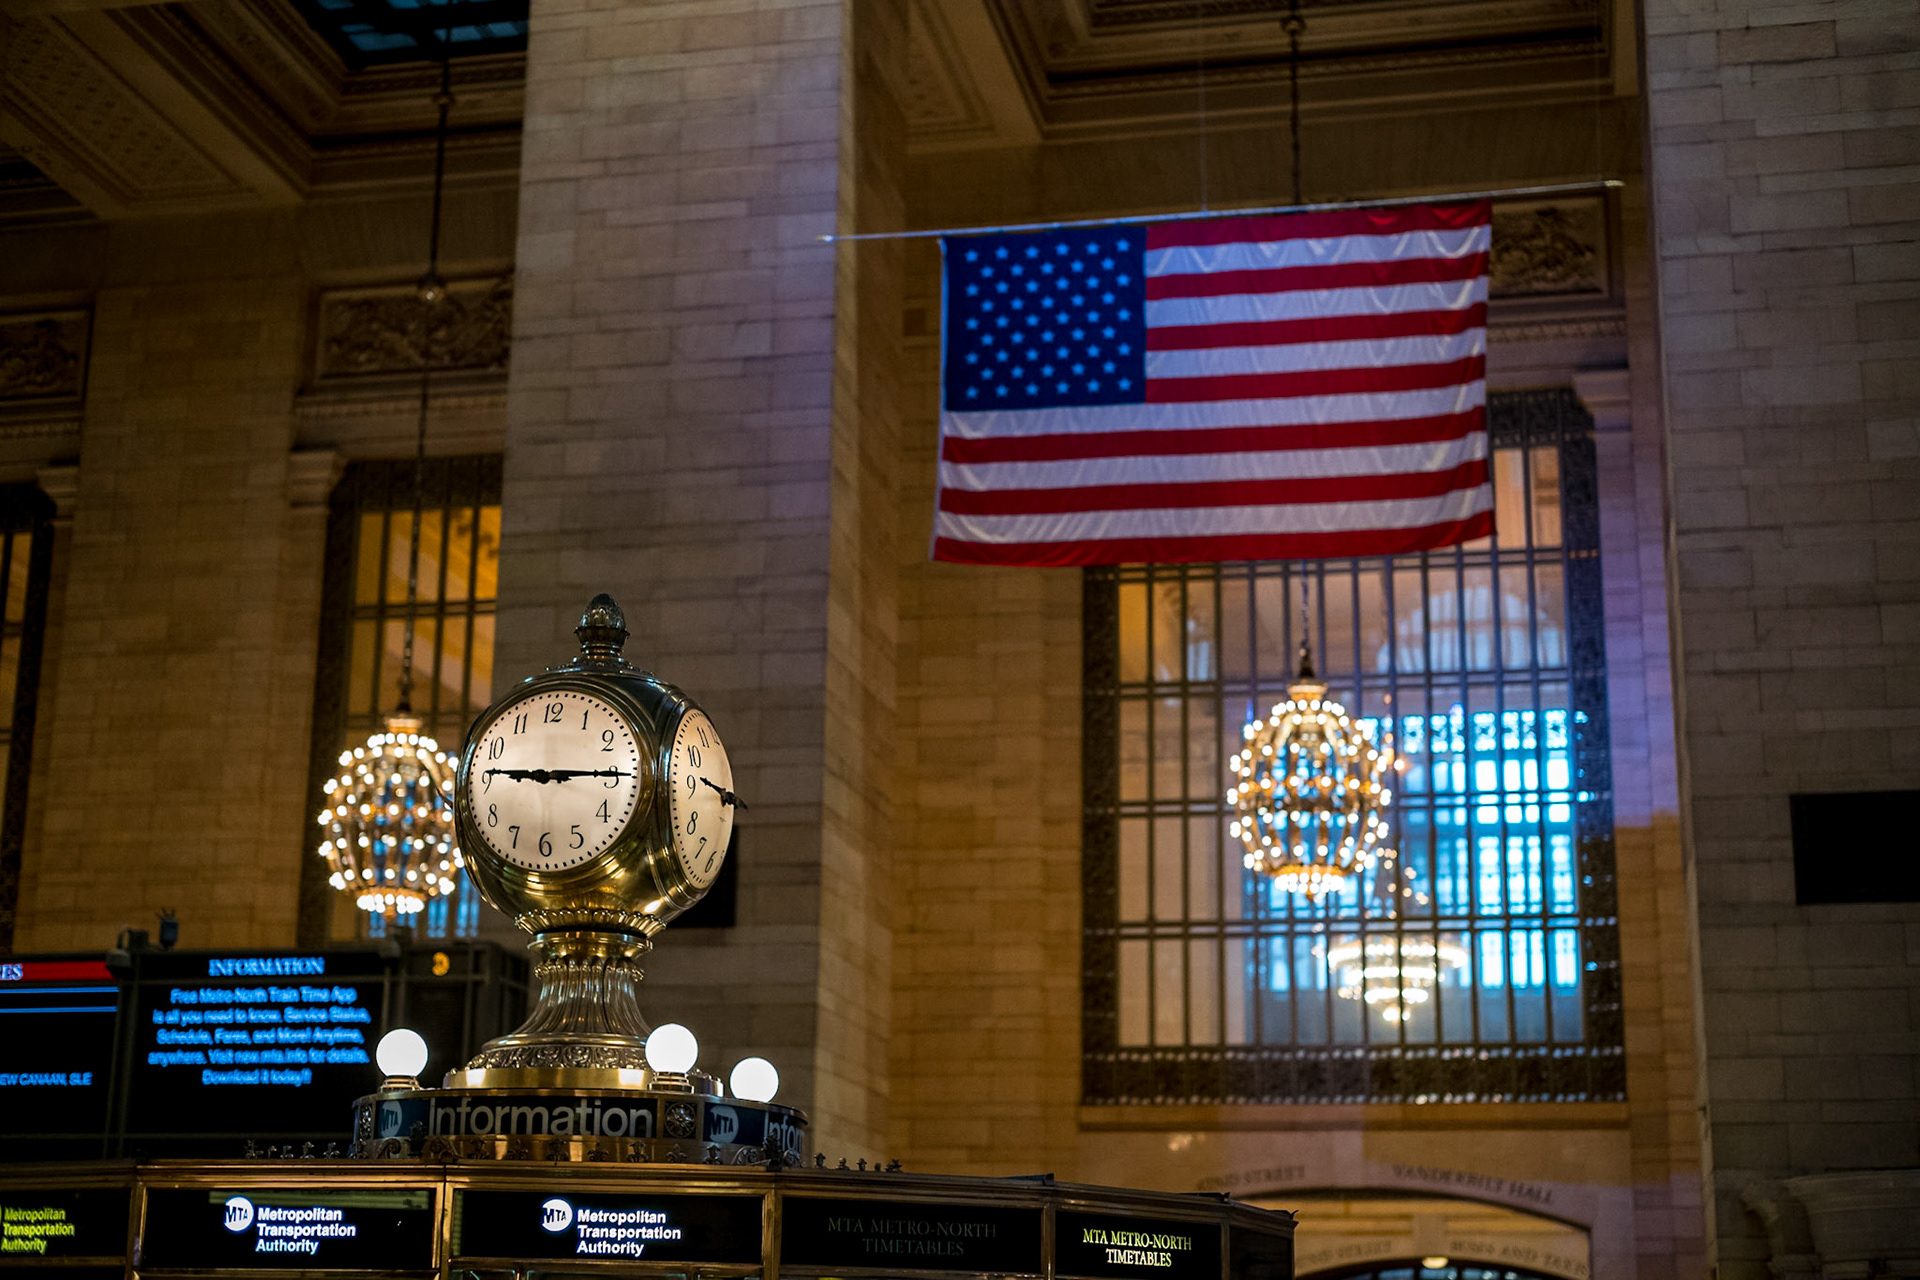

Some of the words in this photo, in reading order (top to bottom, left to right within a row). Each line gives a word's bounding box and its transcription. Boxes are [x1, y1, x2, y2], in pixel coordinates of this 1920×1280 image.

[512, 713, 528, 735] 11
[543, 702, 564, 724] 12
[581, 709, 590, 731] 1
[601, 729, 615, 752] 2
[696, 726, 710, 748] 11
[487, 736, 505, 761] 10
[687, 744, 701, 769] 10
[481, 770, 493, 795] 9
[603, 765, 620, 789] 3
[686, 774, 697, 800] 9
[487, 803, 499, 828] 8
[595, 799, 612, 824] 4
[686, 811, 698, 835] 8
[508, 825, 521, 850] 7
[538, 832, 552, 857] 6
[569, 824, 584, 849] 5
[694, 836, 707, 860] 7
[704, 850, 717, 874] 6
[208, 957, 325, 976] INFORMATION
[170, 988, 198, 1003] Free
[199, 987, 268, 1003] Metro-North
[268, 986, 299, 1002] Train
[299, 986, 330, 1002] Time
[330, 986, 357, 1004] App
[429, 1097, 653, 1137] Information
[4, 1206, 66, 1222] Metropolitan
[257, 1207, 343, 1224] Metropolitan
[577, 1208, 667, 1226] Metropolitan
[3, 1222, 75, 1238] Transportation
[256, 1222, 357, 1239] Transportation
[577, 1224, 682, 1241] Transportation
[828, 1216, 864, 1233] MTA
[870, 1218, 997, 1238] METRO-NORTH
[1, 1237, 47, 1255] Authority
[255, 1238, 319, 1255] Authority
[576, 1240, 645, 1257] Authority
[862, 1238, 965, 1257] TIMETABLES
[1082, 1228, 1109, 1245] MTA
[1110, 1230, 1192, 1251] METRO-NORTH
[1105, 1248, 1172, 1268] TIMETABLES
